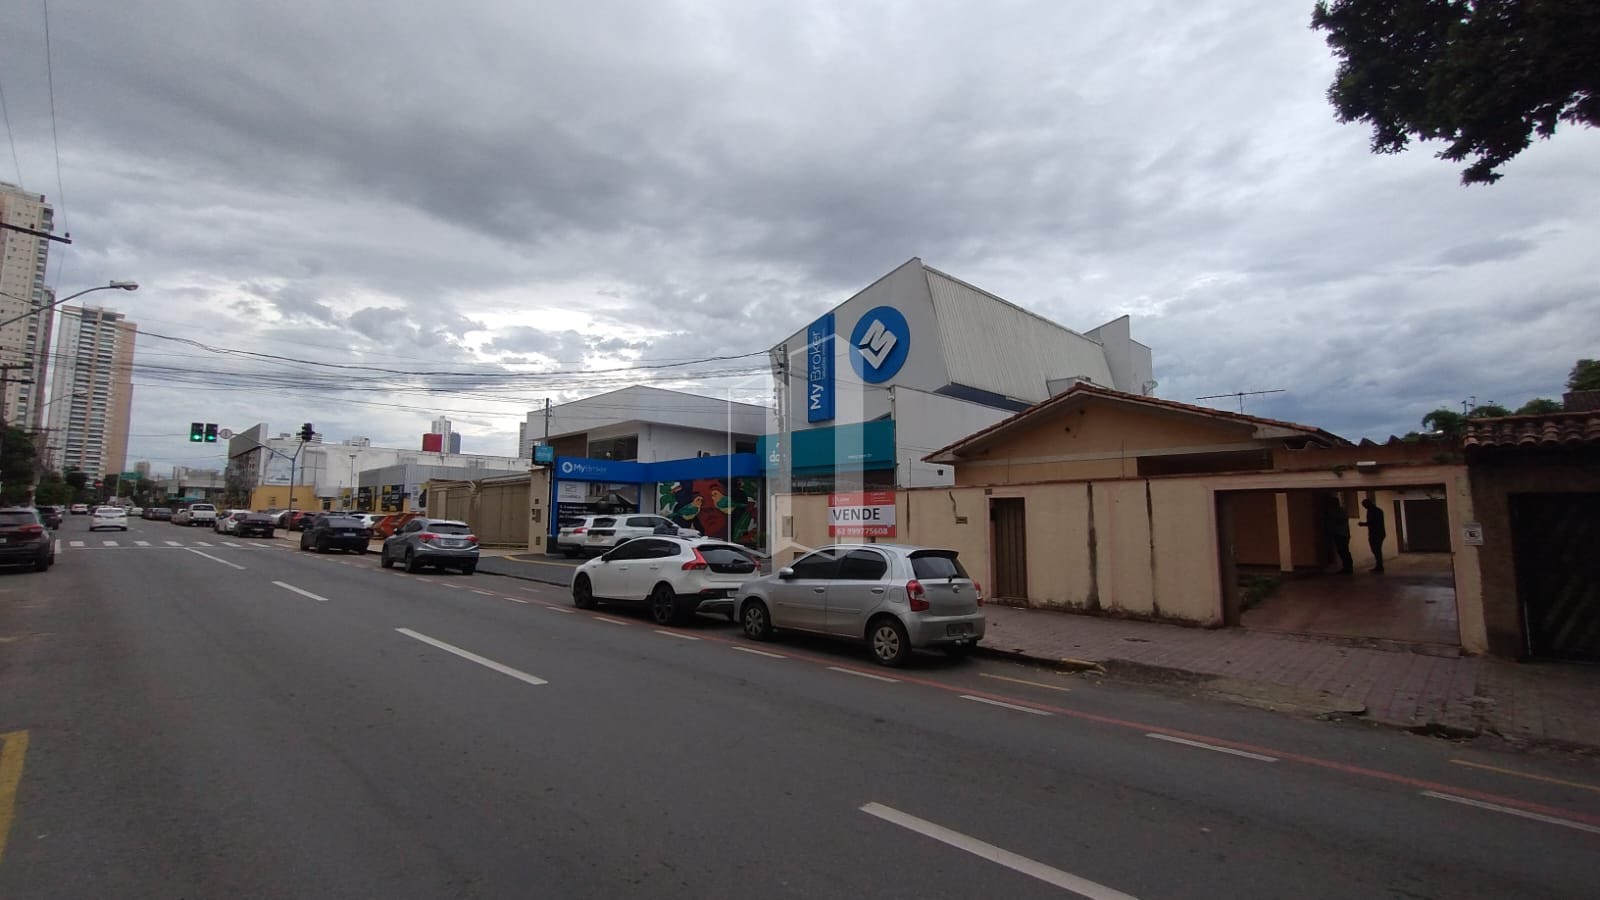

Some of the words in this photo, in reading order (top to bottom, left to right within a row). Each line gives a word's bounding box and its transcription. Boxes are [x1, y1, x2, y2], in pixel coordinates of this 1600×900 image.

[810, 331, 822, 382] Broker
[810, 384, 824, 410] My
[833, 508, 880, 521] VENDE
